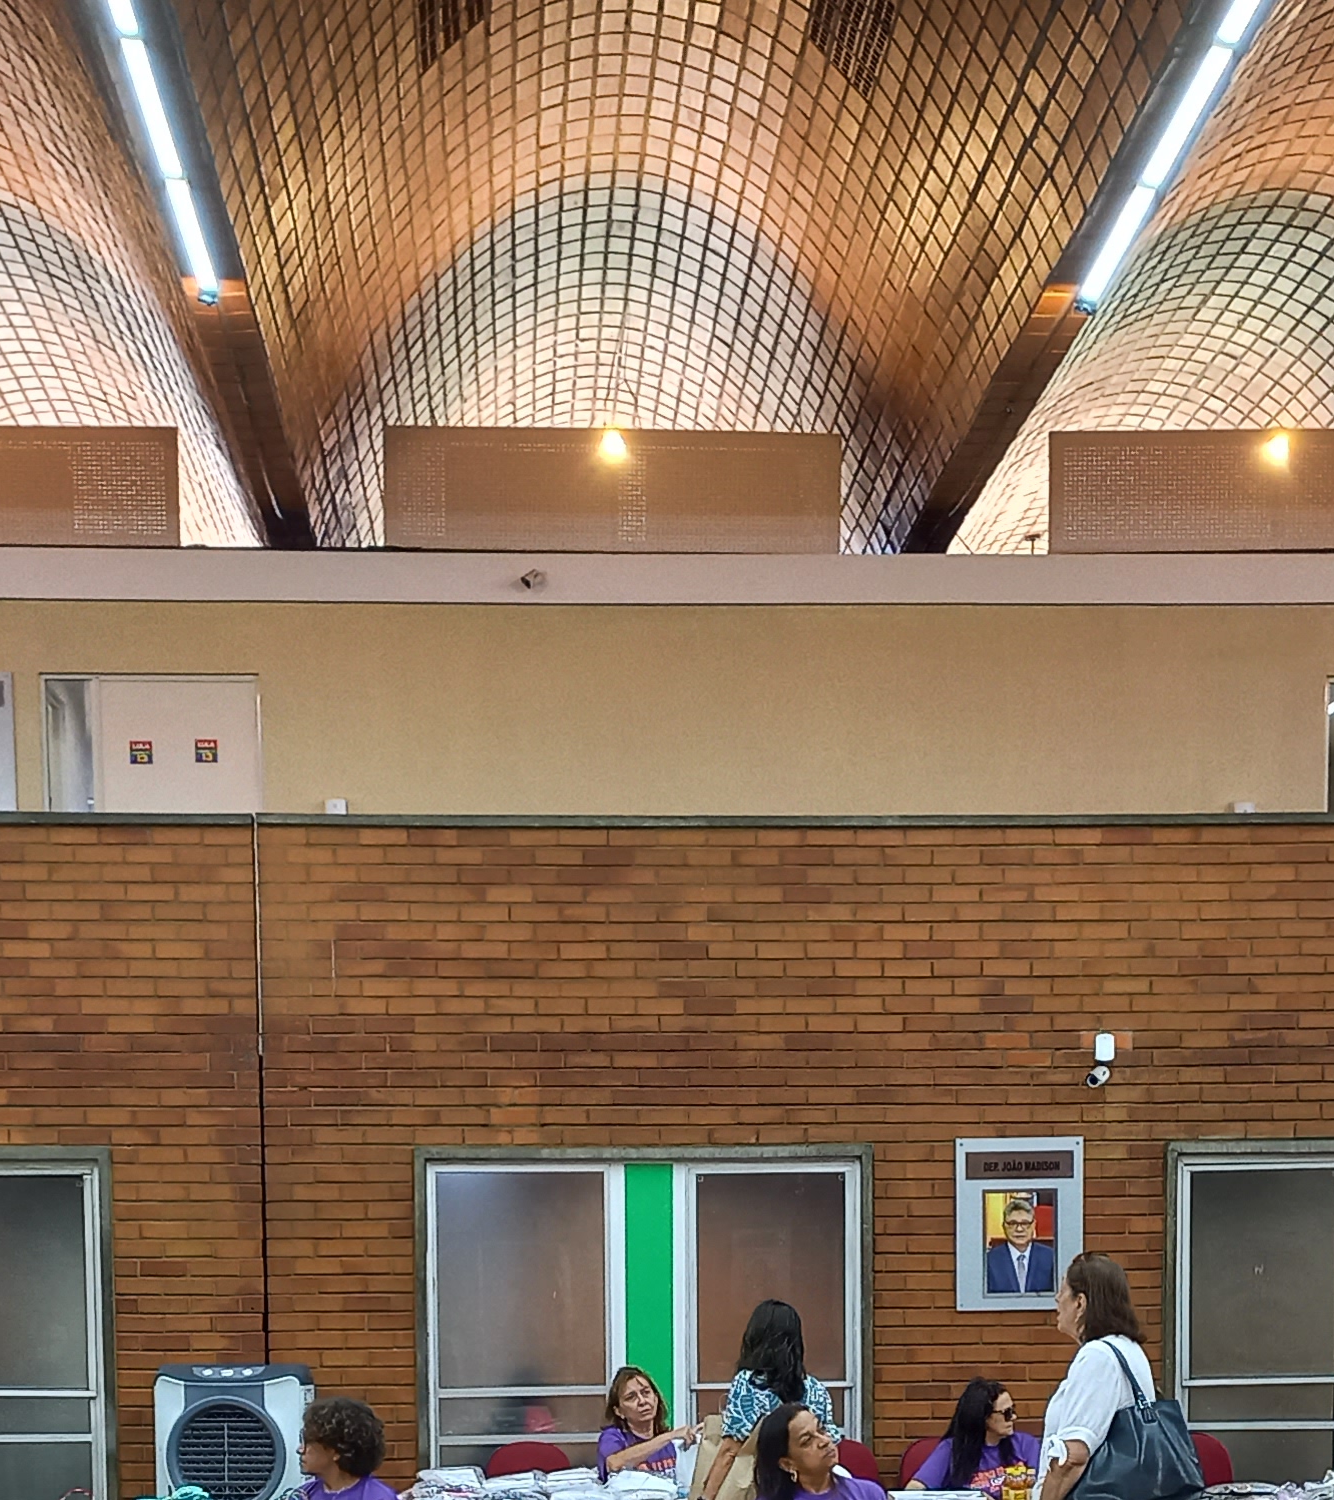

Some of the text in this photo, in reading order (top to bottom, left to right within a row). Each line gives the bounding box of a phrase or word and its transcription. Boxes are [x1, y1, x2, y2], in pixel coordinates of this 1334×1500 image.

[983, 1159, 1061, 1173] DEP. JOÃO MADISON
